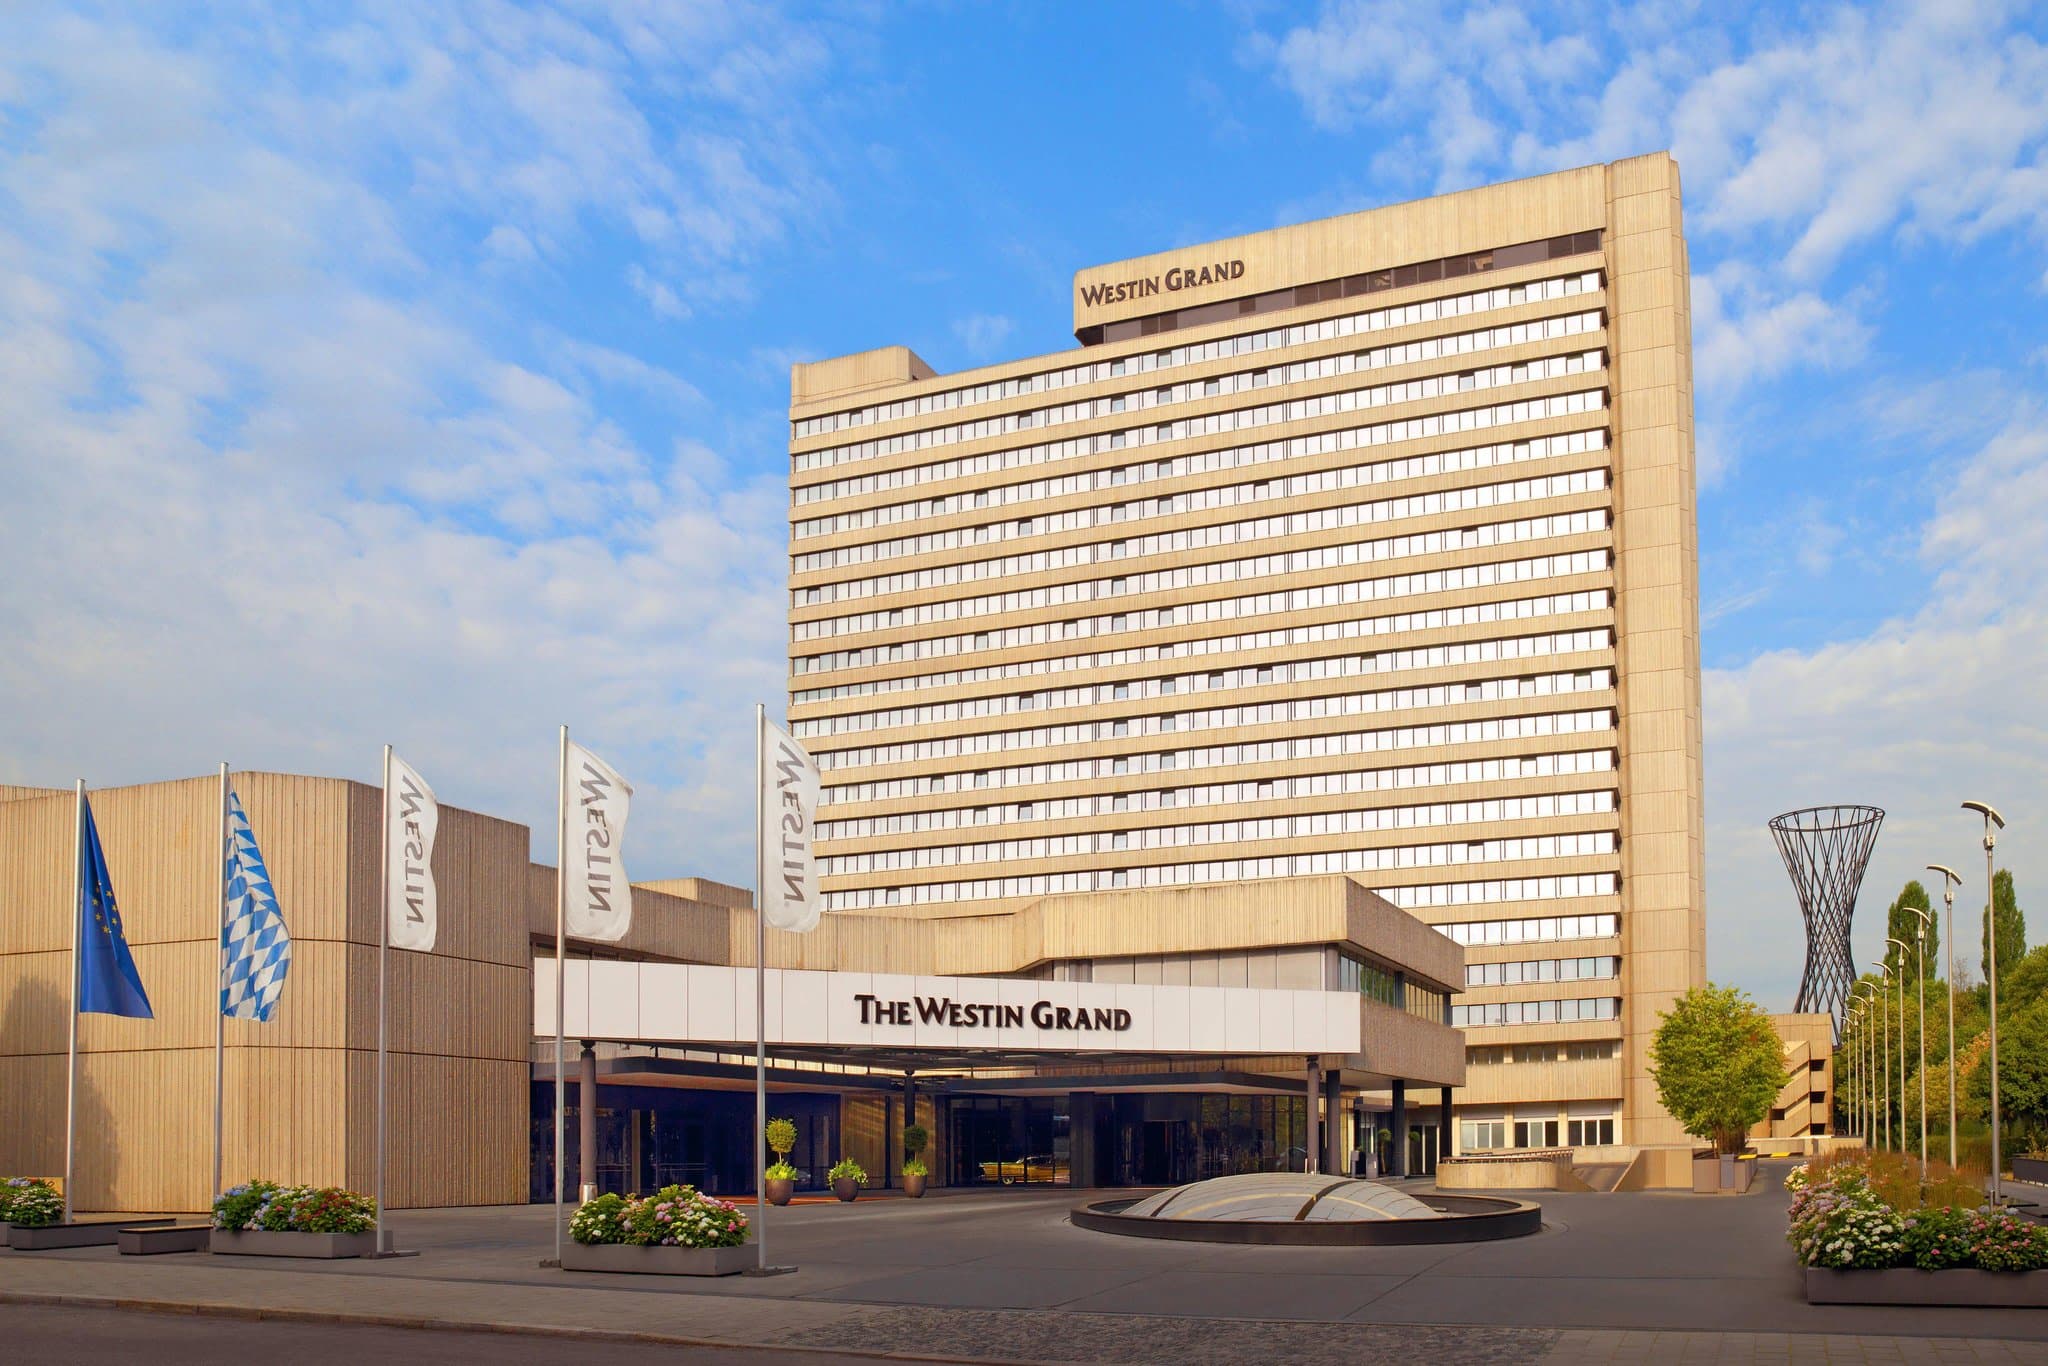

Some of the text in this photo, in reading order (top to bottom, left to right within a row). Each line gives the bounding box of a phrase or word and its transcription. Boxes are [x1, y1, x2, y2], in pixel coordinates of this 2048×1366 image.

[1080, 259, 1245, 308] WESTIN GRAND
[854, 994, 1132, 1031] THE WESTIN GRAND
